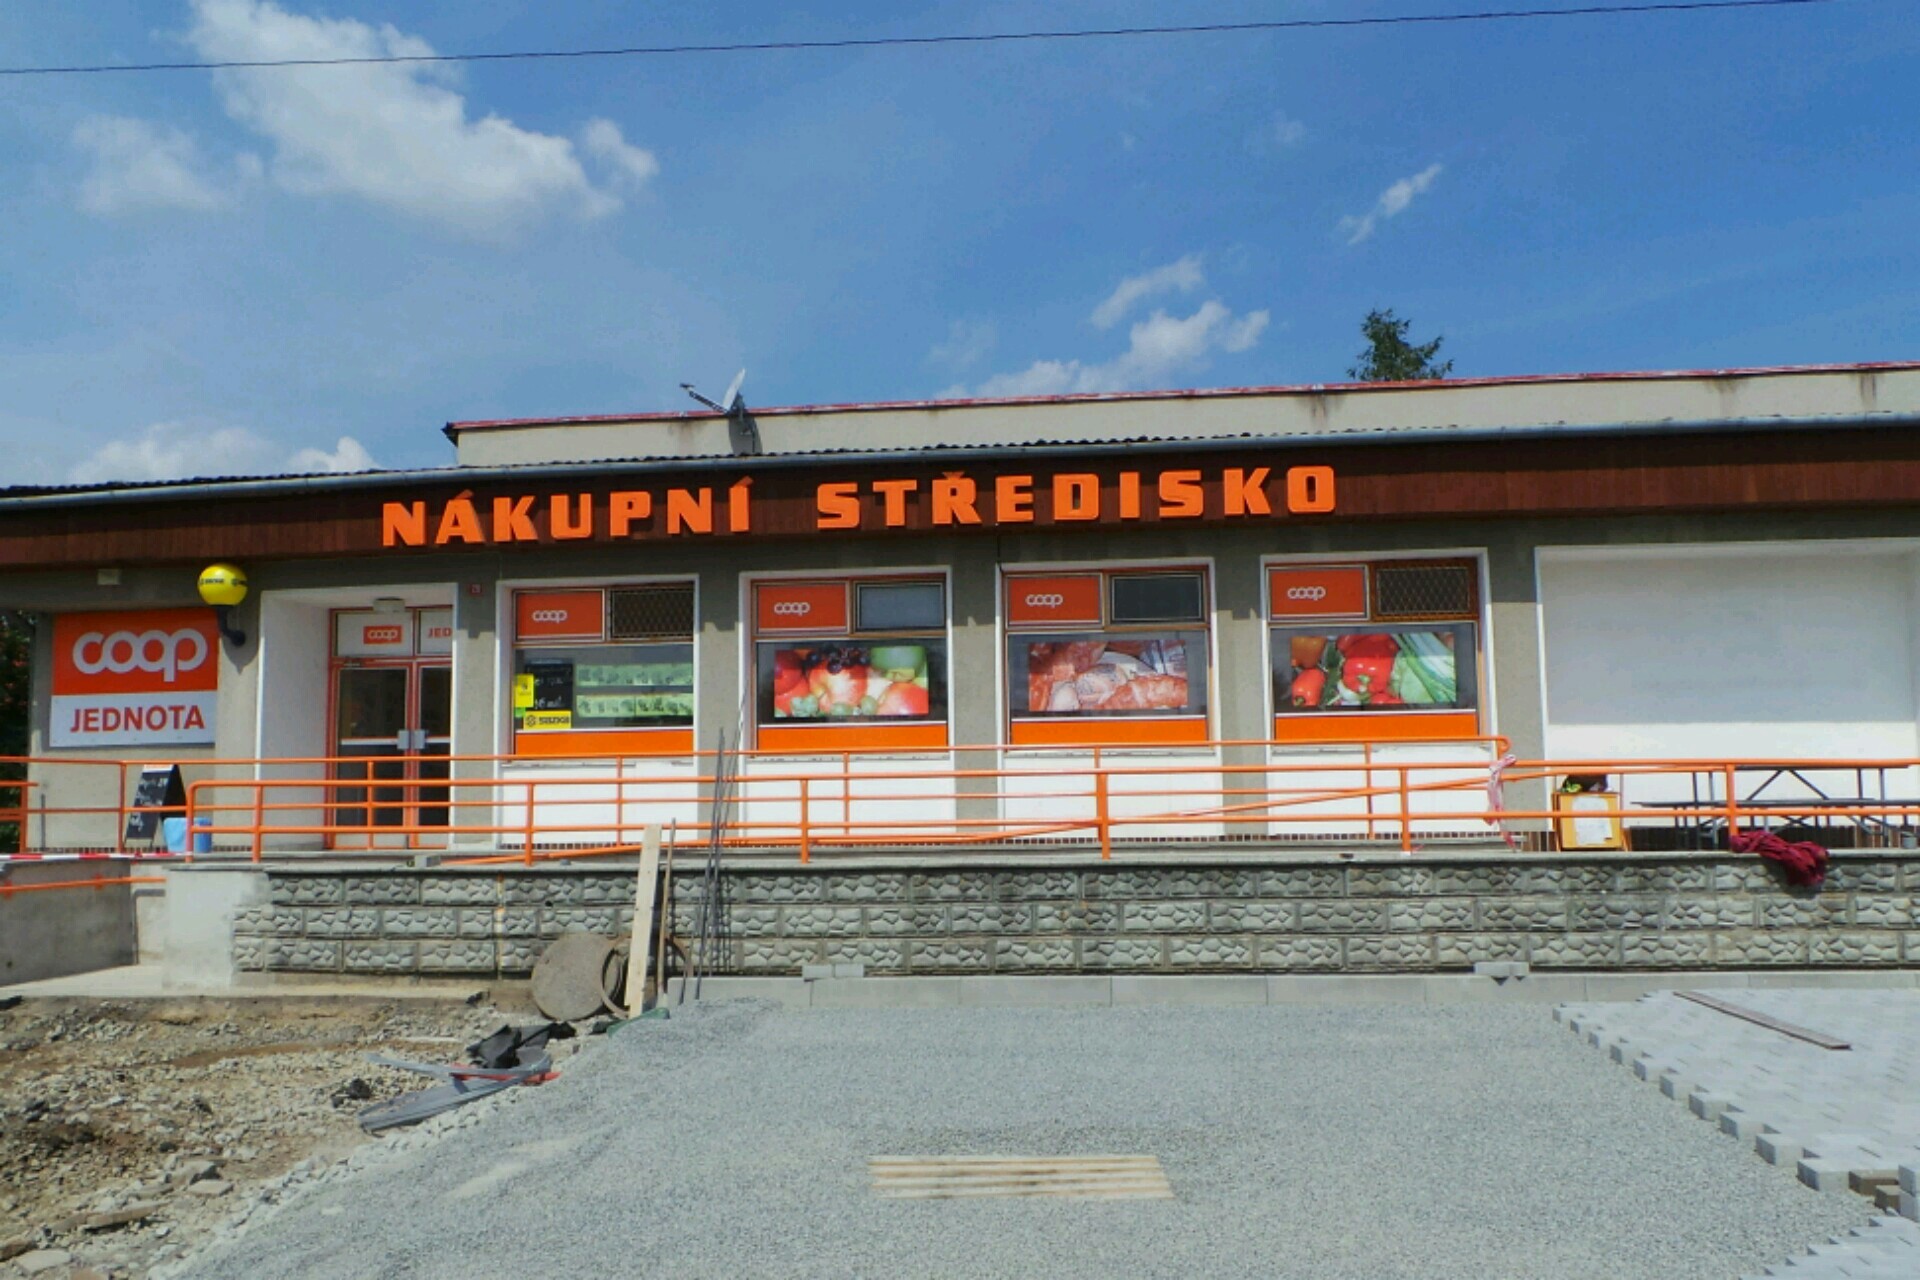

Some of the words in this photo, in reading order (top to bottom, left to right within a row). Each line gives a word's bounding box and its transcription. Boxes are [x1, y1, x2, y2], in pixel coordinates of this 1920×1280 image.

[383, 476, 753, 546] NÁKUPNÍ
[816, 465, 1336, 530] STŘEDISKO
[1026, 594, 1063, 608] coop
[1286, 586, 1326, 601] coop
[773, 602, 811, 615] coop
[531, 610, 568, 623] coop
[71, 627, 208, 683] coop
[70, 705, 205, 733] JEDNOTA
